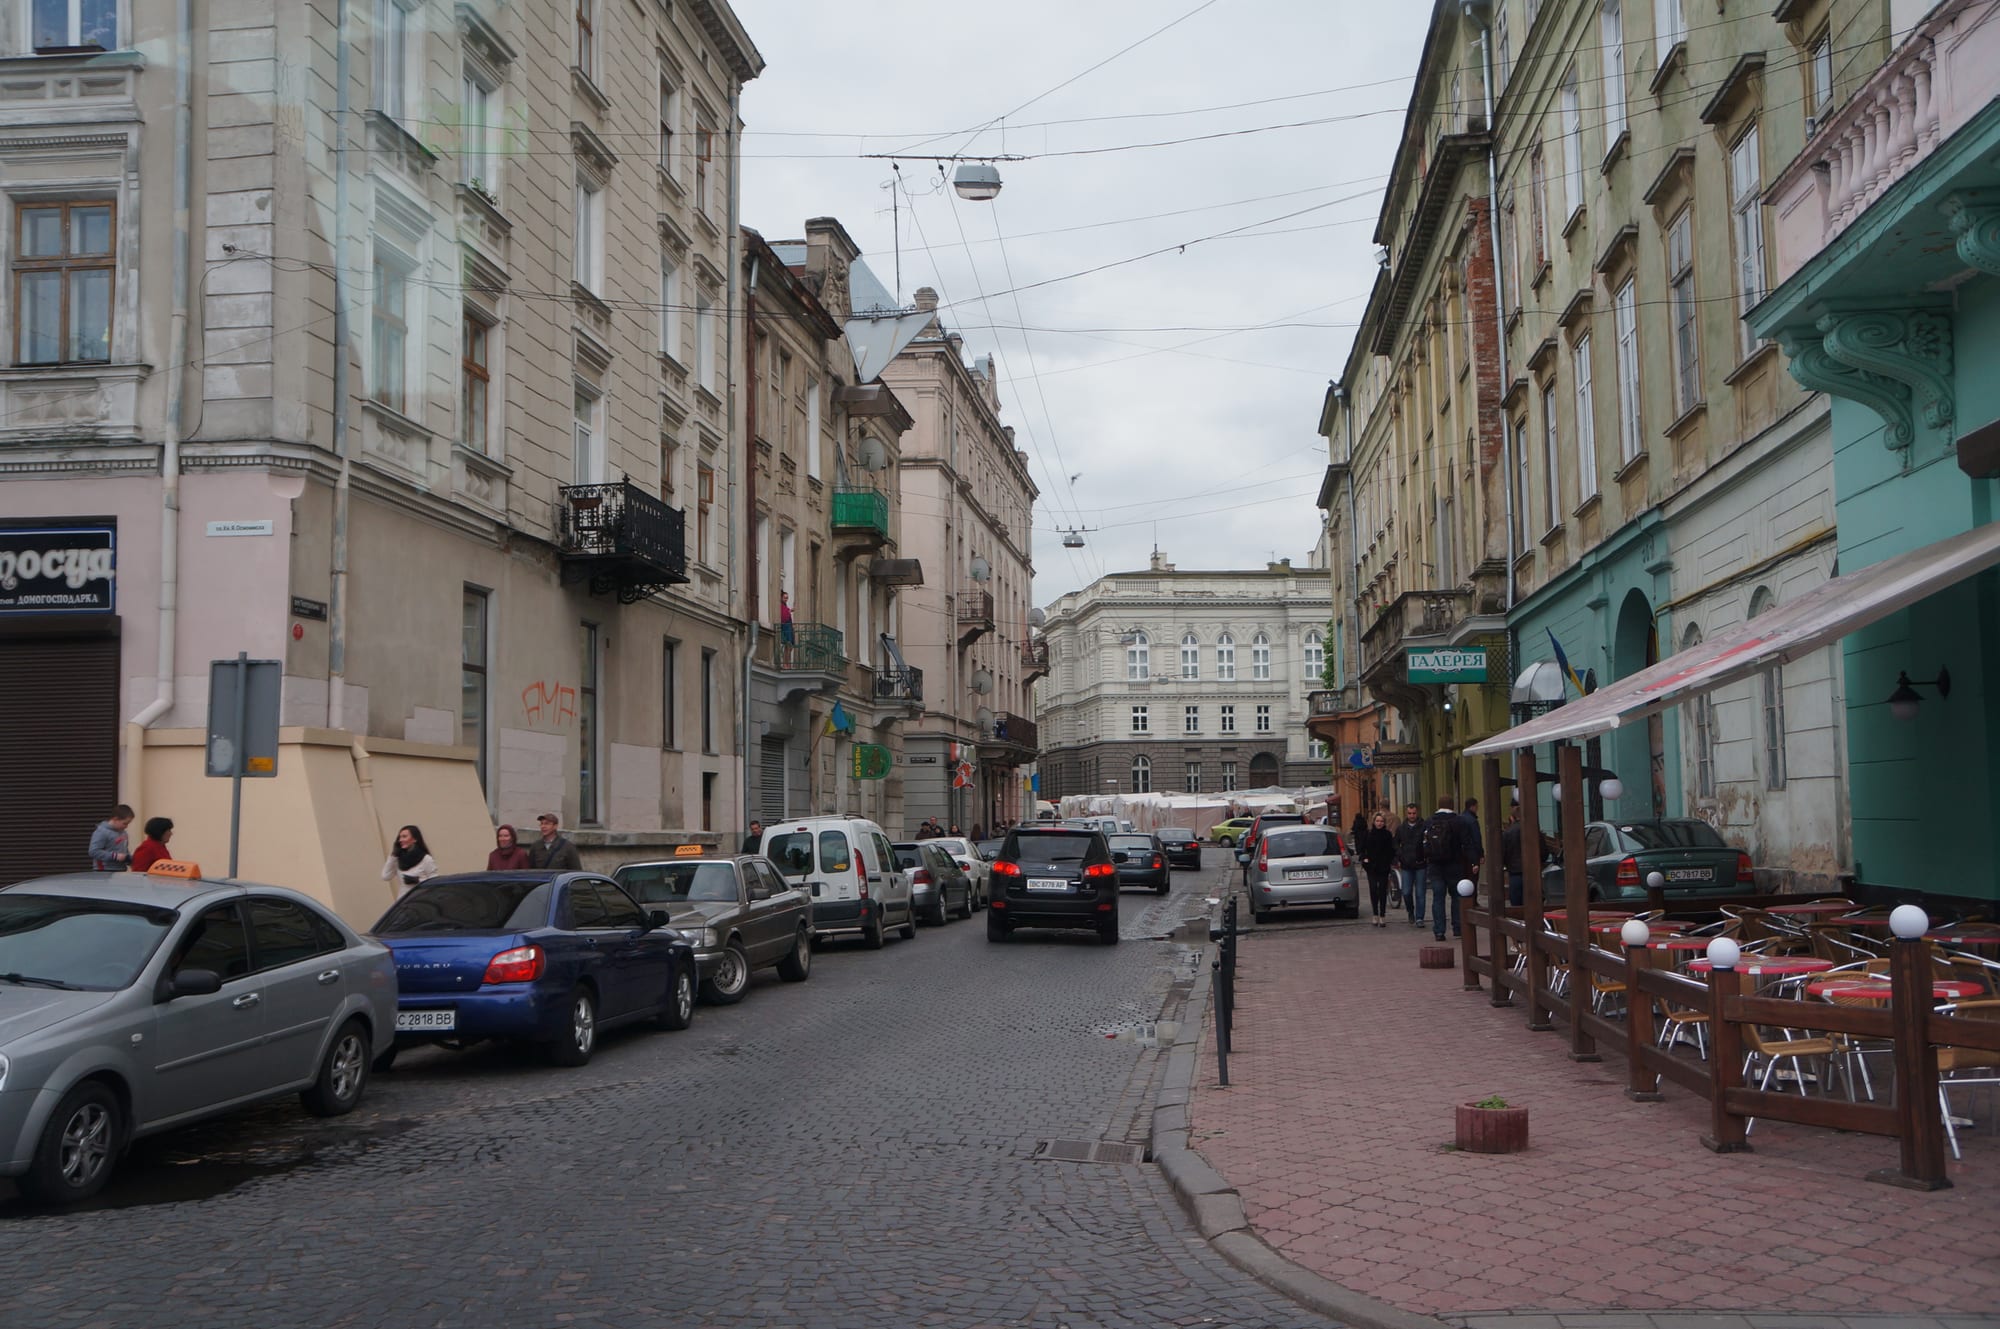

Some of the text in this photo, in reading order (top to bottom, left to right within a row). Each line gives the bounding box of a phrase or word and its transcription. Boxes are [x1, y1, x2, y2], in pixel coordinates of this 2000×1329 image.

[17, 594, 98, 605] ДОМОГОСПОДАРКА
[1411, 654, 1484, 667] ГАЛЕРЕЯ
[1671, 871, 1681, 879] BC
[1682, 870, 1699, 878] 7817
[396, 1013, 451, 1025] C 2818 BB
